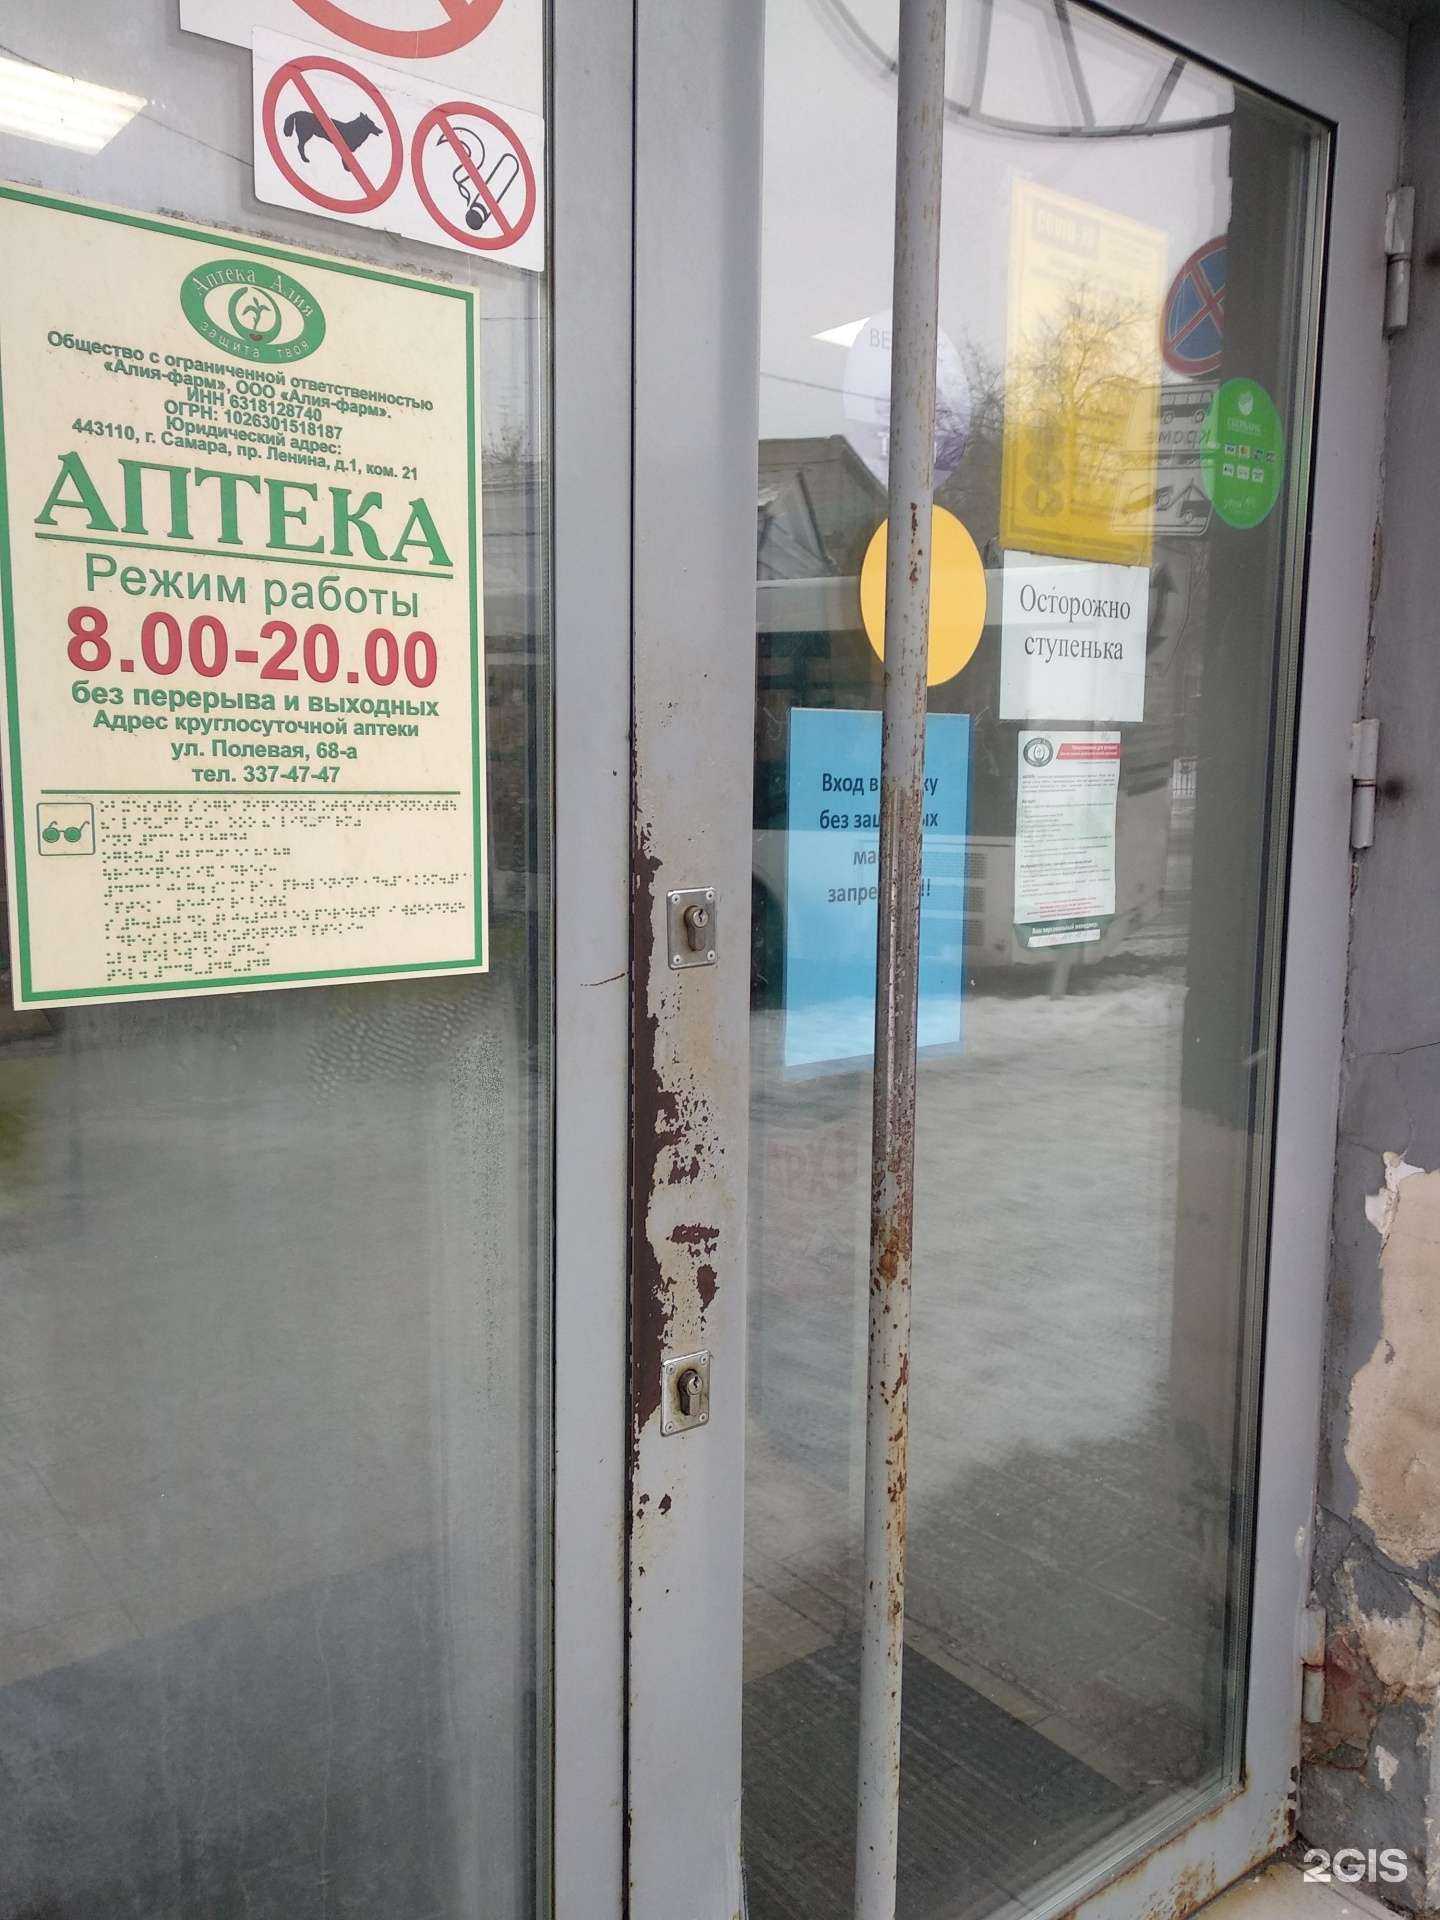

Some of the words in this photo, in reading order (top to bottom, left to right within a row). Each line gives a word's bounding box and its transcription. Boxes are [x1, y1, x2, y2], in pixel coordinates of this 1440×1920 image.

[192, 268, 256, 296] Аптека
[270, 274, 314, 318] Алия
[47, 330, 145, 362] Общество
[149, 352, 160, 364] с
[164, 354, 286, 386] ограниченной
[290, 376, 434, 411] ответственностью
[104, 358, 231, 394] «Алия-фарм»,
[235, 379, 276, 399] ООО
[280, 389, 392, 418] «Алия-фарм».
[164, 399, 219, 421] ОГРН:
[224, 409, 343, 440] 1026301518187
[187, 386, 225, 407] ИНН
[229, 394, 322, 422] 6318128740
[72, 418, 140, 444] 443110,
[145, 432, 156, 443] г.
[161, 431, 232, 457] Самара,
[237, 445, 262, 460] пр.
[266, 446, 330, 470] Ленина,
[334, 458, 362, 475] д.1,
[366, 463, 398, 478] ком.
[402, 465, 418, 481] 21
[166, 415, 286, 447] Юридический
[290, 438, 342, 455] адрес:
[34, 450, 454, 568] АПТЕКА
[85, 552, 247, 604] Режим
[264, 575, 420, 617] работы
[1020, 584, 1131, 624] Осторожно
[66, 605, 438, 689] 8.00-20.00
[1024, 636, 1124, 663] ступенька
[71, 679, 125, 705] без
[133, 687, 276, 714] перерыва
[284, 694, 299, 712] и
[308, 695, 440, 719] выходных
[93, 709, 169, 734] Адрес
[175, 716, 348, 737] круглосуточной
[353, 721, 420, 737] аптеки
[170, 741, 205, 761] ул.
[211, 738, 311, 762] Полевая,
[316, 741, 358, 760] 68-а
[191, 767, 237, 783] тел.
[243, 764, 341, 783] 337-47-47
[822, 773, 865, 796] Вход
[869, 777, 878, 792] в
[819, 809, 849, 829] без
